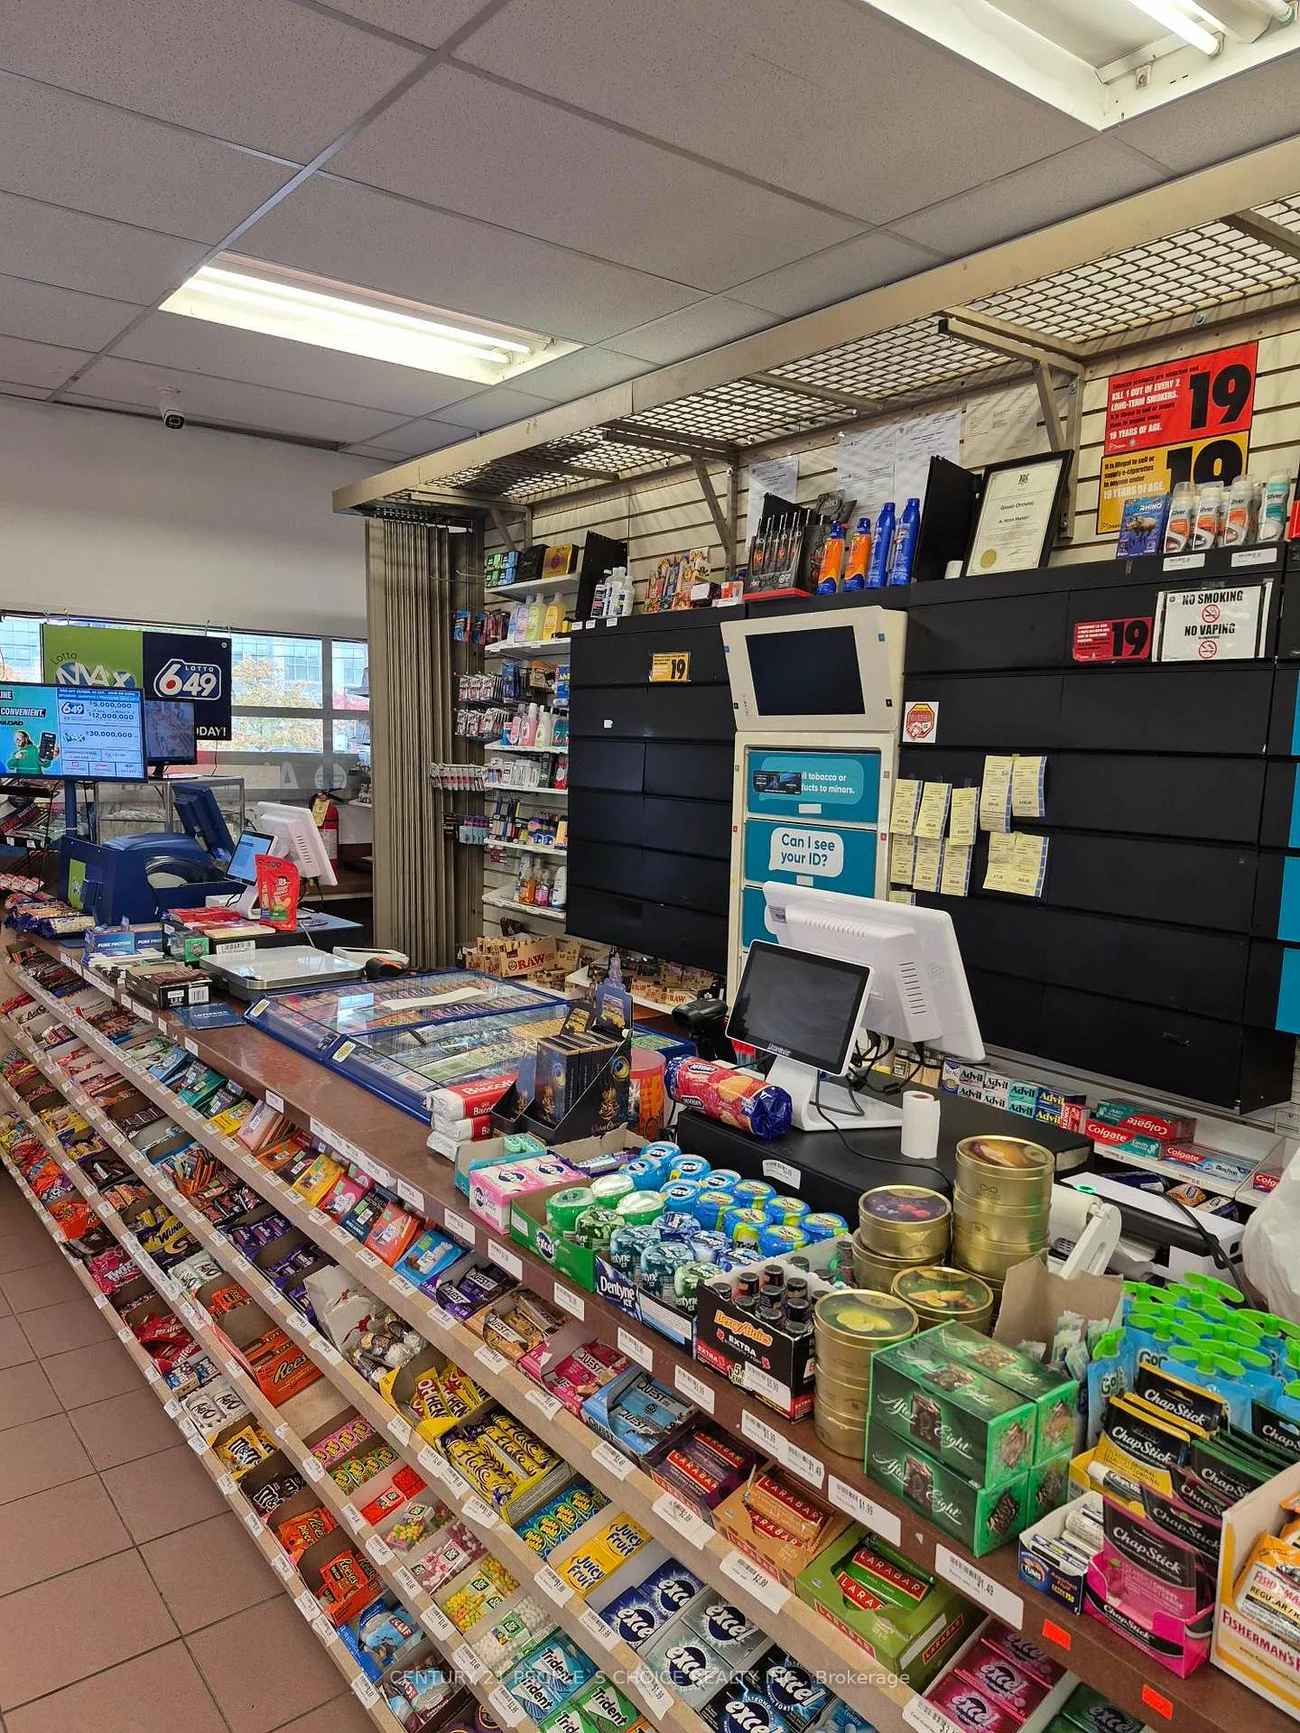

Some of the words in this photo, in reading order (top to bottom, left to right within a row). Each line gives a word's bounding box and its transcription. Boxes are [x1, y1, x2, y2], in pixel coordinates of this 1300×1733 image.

[1111, 390, 1125, 401] KILL
[1130, 386, 1143, 397] OUT
[1144, 384, 1153, 393] OF
[1153, 380, 1174, 392] EVERY
[1175, 378, 1181, 387] 2
[1189, 363, 1251, 430] 19
[1110, 397, 1145, 412] LONG-TERM
[1146, 390, 1179, 405] SMOKERS.
[1109, 432, 1117, 440] 19
[1118, 428, 1138, 439] YEARS
[1139, 425, 1148, 434] OF
[1148, 422, 1163, 433] AGE.
[1138, 456, 1149, 465] sell
[1104, 469, 1121, 480] supply
[1122, 464, 1154, 476] e-cigarettes
[1103, 489, 1112, 499] 19
[1113, 485, 1137, 498] YEARS
[1137, 483, 1146, 494] OF
[1139, 502, 1162, 512] RHINO
[1182, 594, 1196, 606] NO
[1197, 590, 1243, 604] SMOKING
[1112, 620, 1149, 657] 19
[1184, 625, 1198, 637] NO
[1199, 623, 1236, 636] VAPING
[50, 652, 78, 667] Lotto
[184, 665, 214, 673] LOTTO
[671, 659, 685, 680] 19
[88, 712, 134, 720] $12,000,000
[85, 730, 133, 739] $30,000,000
[808, 772, 838, 783] tobacco
[838, 774, 848, 782] or
[819, 785, 827, 793] to
[828, 785, 856, 795] minors.
[781, 833, 805, 849] Can
[807, 835, 811, 849] I
[814, 838, 836, 852] see
[781, 852, 806, 866] your
[808, 852, 829, 868] ID?
[518, 953, 545, 970] RAW
[961, 1070, 983, 1082] Advil
[988, 1077, 1008, 1090] Advil
[960, 1087, 982, 1100] Advil
[984, 1095, 1006, 1109] Advil
[1012, 1085, 1035, 1098] Advil
[1040, 1092, 1065, 1107] Advil
[1009, 1103, 1033, 1117] Advil
[1087, 1123, 1128, 1143] Colgate
[1127, 1116, 1169, 1137] Colgate
[1167, 1147, 1200, 1163] Colgate
[600, 1275, 636, 1300] Dentyne
[623, 1299, 632, 1307] ICE
[697, 1345, 718, 1363] EXTRA
[729, 1335, 757, 1357] EXTRA
[578, 1351, 603, 1373] QUEST
[636, 1382, 665, 1404] QUEST
[878, 1394, 917, 1426] After
[1144, 1388, 1208, 1427] ChapStick
[619, 1410, 649, 1430] QUEST
[935, 1421, 974, 1461] Eight
[1111, 1426, 1173, 1464] ChapStick
[673, 1453, 719, 1490] LARABAR
[873, 1453, 908, 1487] After
[763, 1477, 822, 1521] LARABAR
[926, 1484, 963, 1526] Eight
[606, 1532, 635, 1557] Fruit
[616, 1523, 643, 1548] Juicy
[1112, 1526, 1181, 1574] ChapStick
[566, 1563, 597, 1590] Fruit
[577, 1555, 605, 1581] Juicy
[860, 1550, 921, 1593] LARABAR
[752, 1571, 769, 1588] $2.99
[705, 1604, 757, 1643] excel
[1103, 1604, 1153, 1640] ChapStick
[1222, 1609, 1295, 1667] FISHERMAN'S
[541, 1648, 575, 1683] Trident
[664, 1647, 716, 1691] excel
[767, 1665, 827, 1708] excel
[981, 1662, 1029, 1698] excel
[521, 1676, 554, 1710] Trident
[592, 1687, 628, 1726] Trident
[952, 1694, 999, 1728] excel
